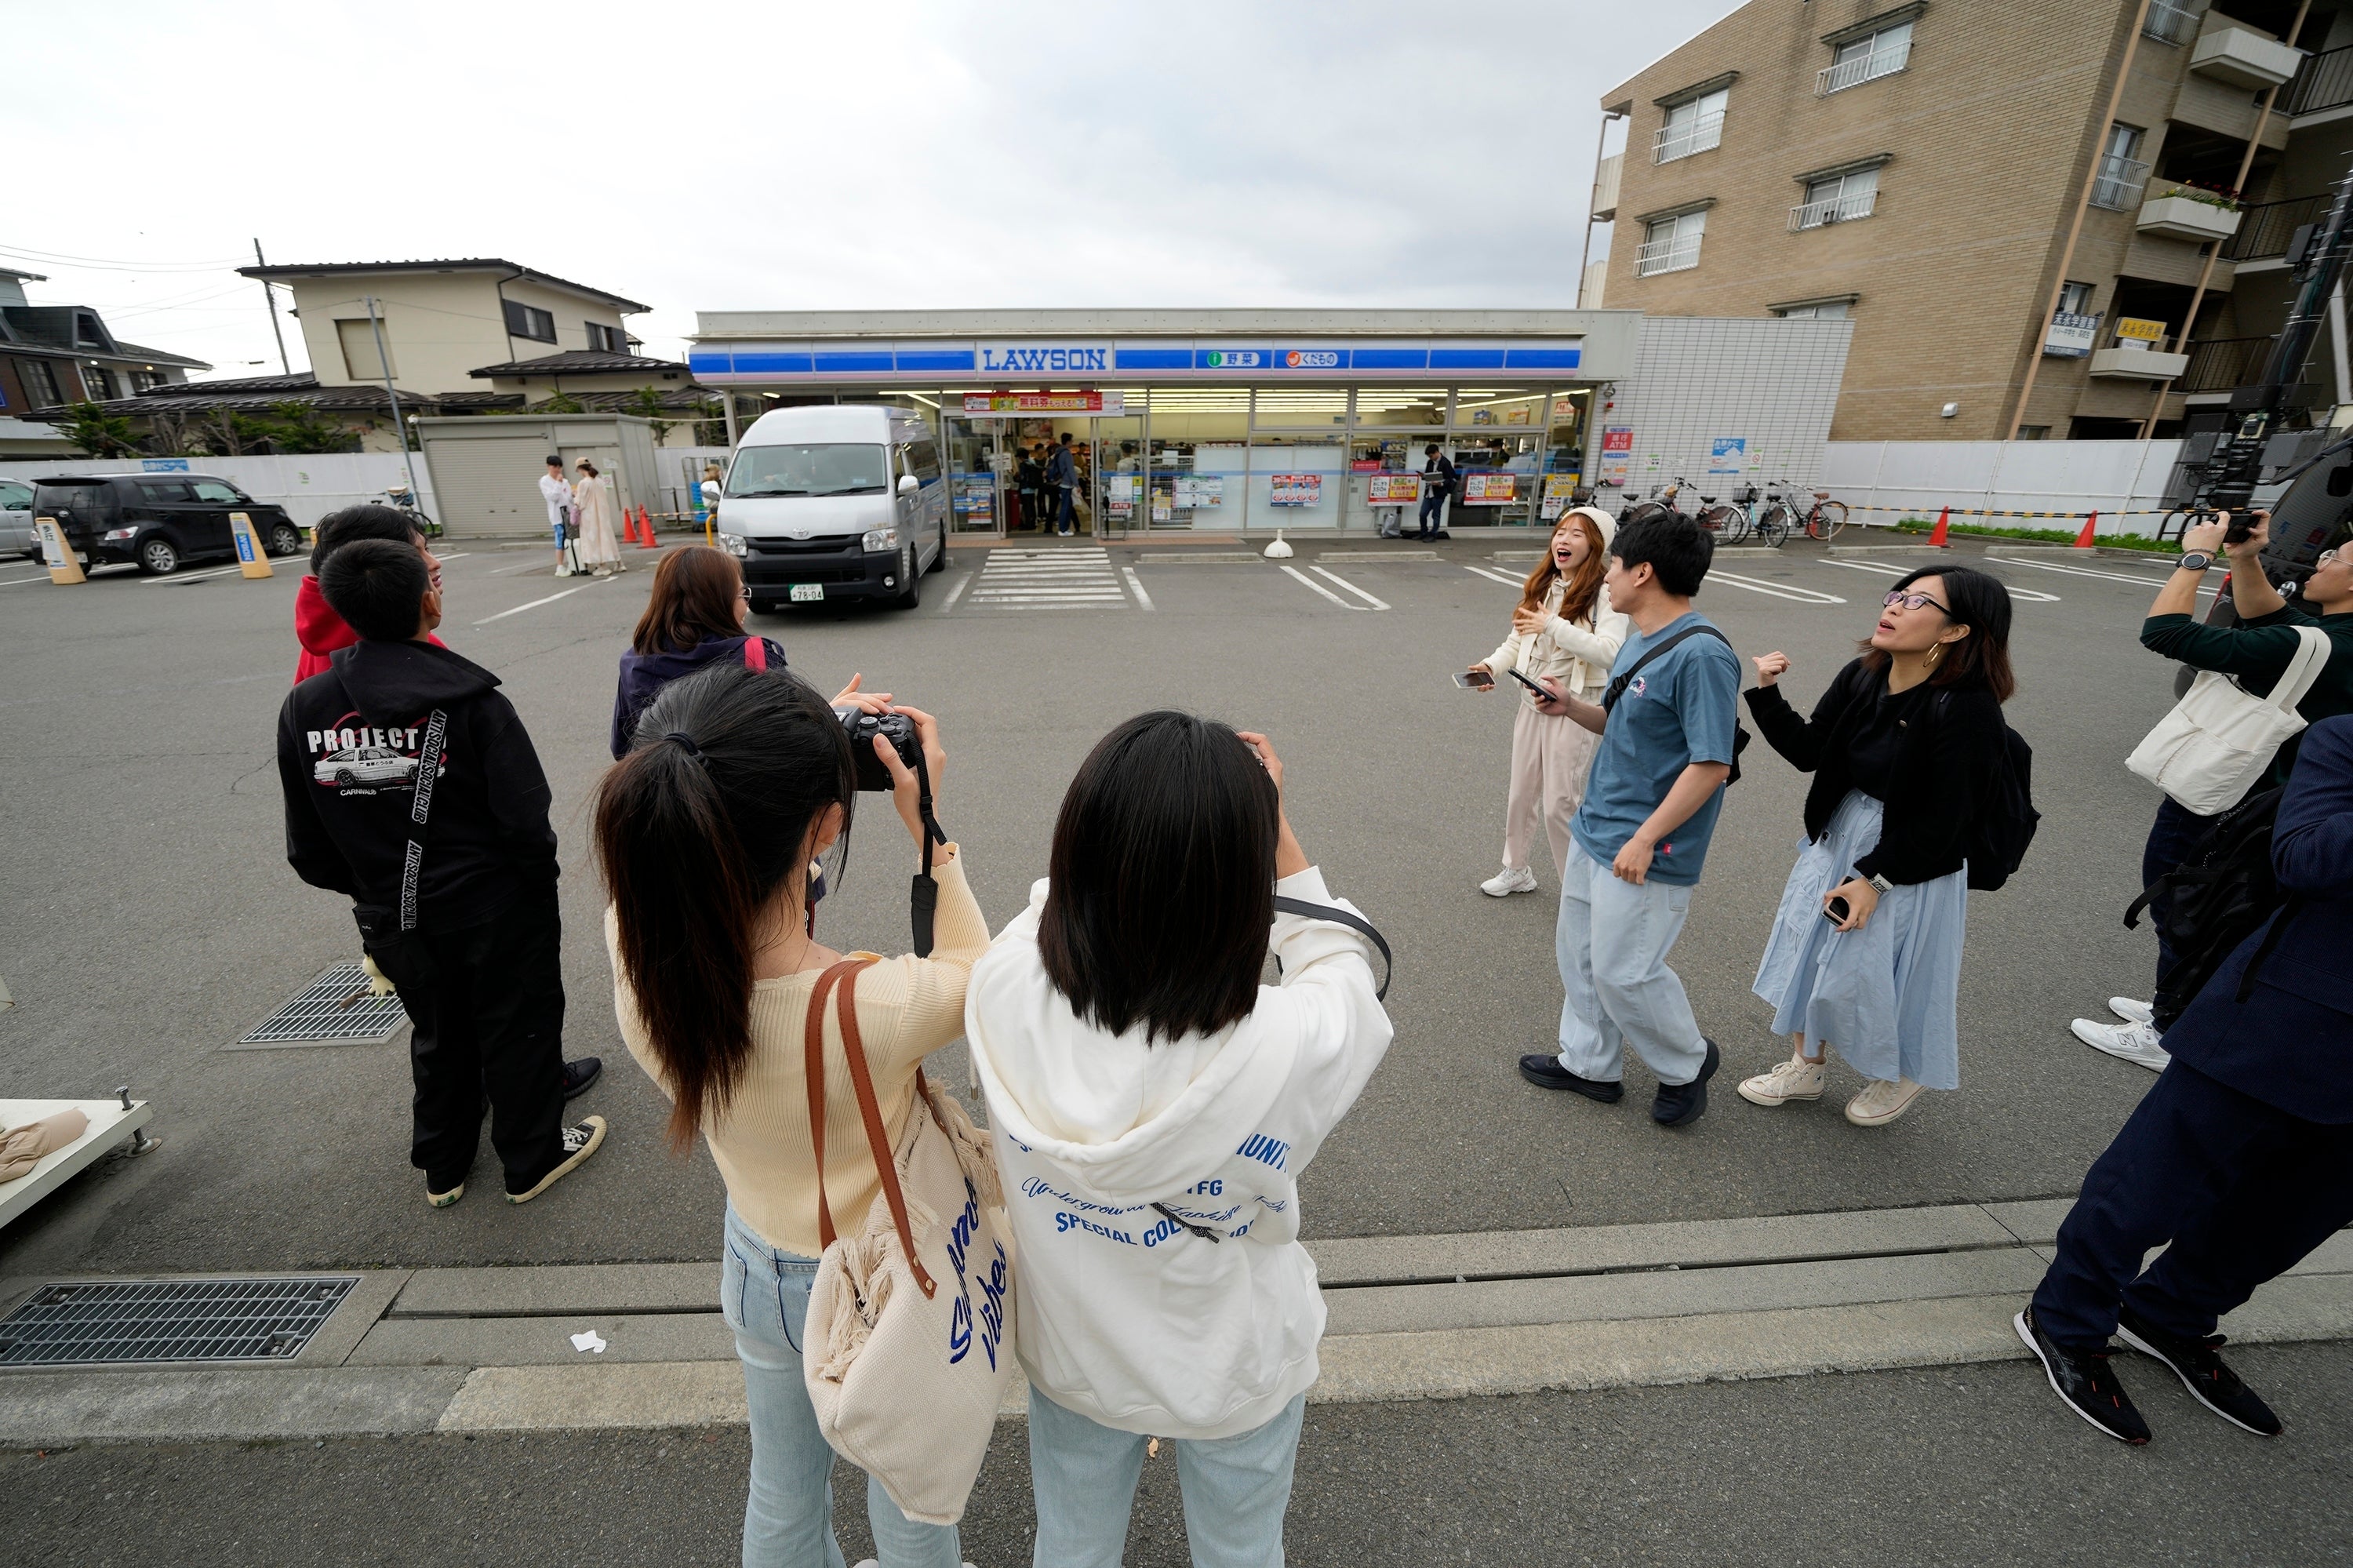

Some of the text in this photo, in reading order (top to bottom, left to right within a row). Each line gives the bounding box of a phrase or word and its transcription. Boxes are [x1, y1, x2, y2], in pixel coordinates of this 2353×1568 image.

[983, 348, 1106, 370] LAWSON
[1227, 353, 1253, 365] 野菜
[1302, 353, 1334, 365] くだもの
[307, 727, 418, 753] PROJECT
[1055, 1212, 1138, 1246] SPECIAL
